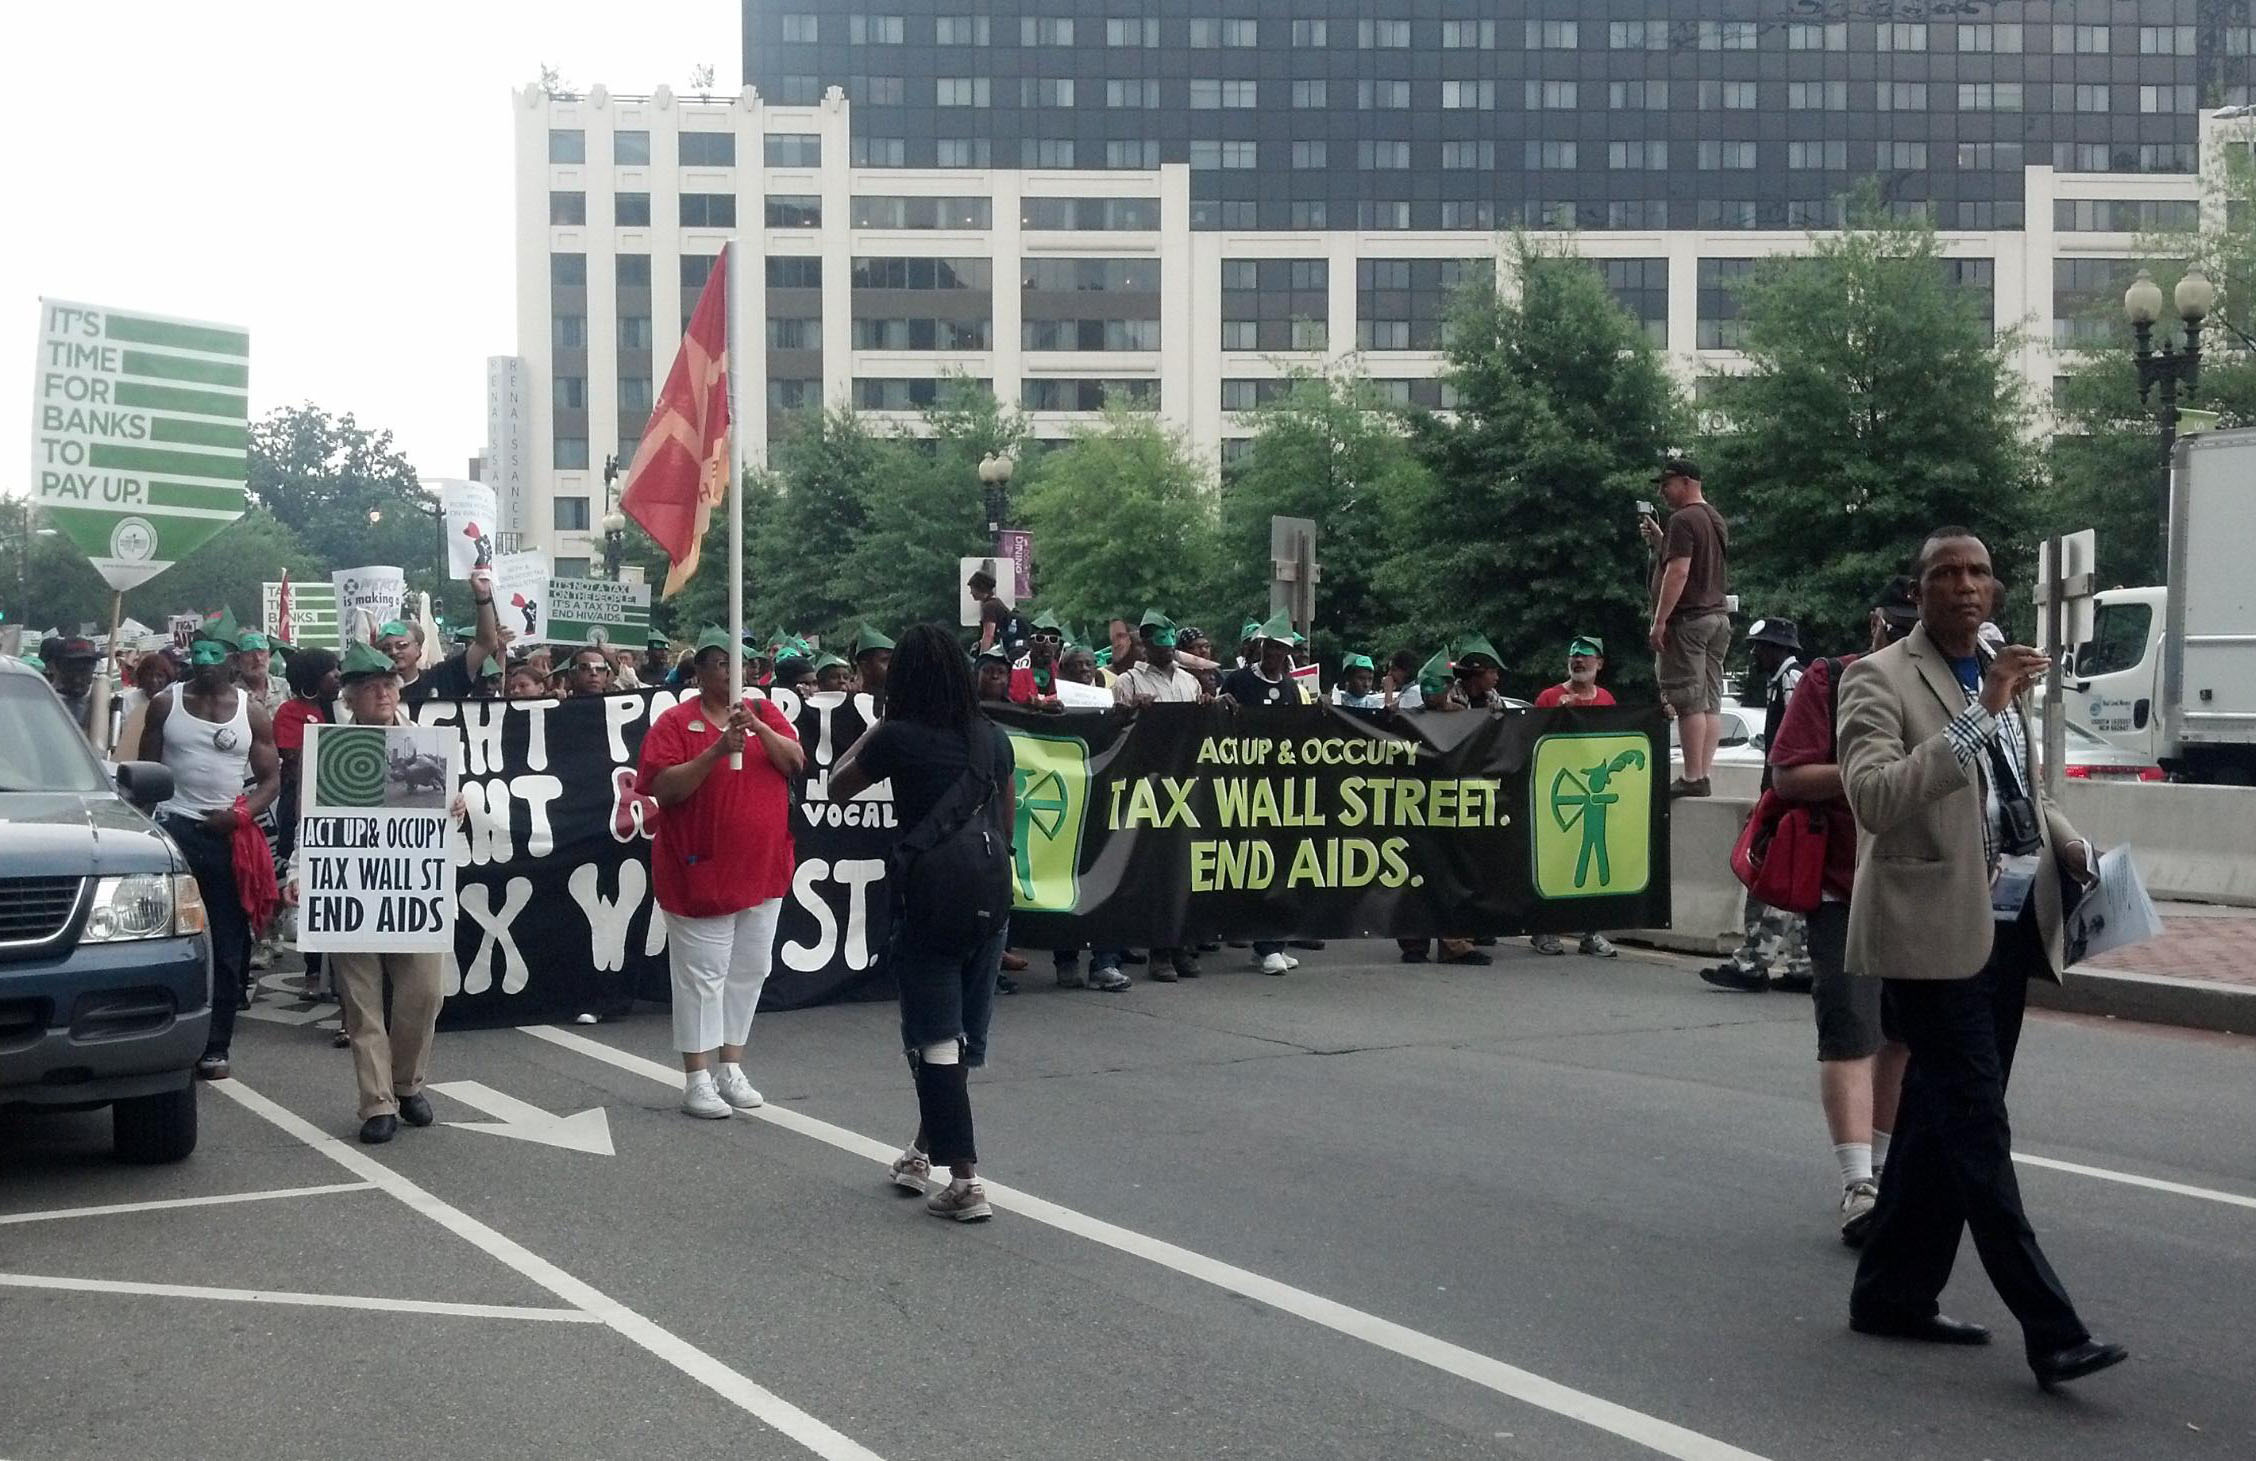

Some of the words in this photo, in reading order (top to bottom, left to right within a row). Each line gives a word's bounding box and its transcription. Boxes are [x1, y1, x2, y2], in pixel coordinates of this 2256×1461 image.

[49, 306, 99, 337] IT'S
[47, 339, 117, 373] TIME
[44, 373, 109, 404] FOR
[41, 405, 146, 440] BANKS
[491, 360, 500, 497] RENAISSAN
[41, 438, 84, 466] TO
[509, 360, 520, 529] RENAISSANCE
[41, 471, 97, 501] PAY
[103, 477, 143, 504] UP.
[1015, 535, 1024, 574] DINING
[343, 596, 352, 607] is
[356, 592, 394, 607] making
[552, 609, 573, 618] END
[553, 600, 570, 608] IT'S
[573, 601, 580, 609] A
[583, 602, 602, 610] TAX
[606, 603, 620, 612] TO
[268, 612, 315, 623] BNKS.
[268, 625, 296, 636] NT
[1277, 738, 1296, 765] &
[1302, 737, 1422, 766] OCCUPY
[801, 802, 898, 828] VOCAL
[1109, 776, 1201, 830] TAX
[1212, 776, 1325, 828] WALL
[1338, 776, 1511, 828] STREET.
[304, 818, 336, 847] ACT
[387, 818, 447, 848] OCCUPY
[309, 857, 349, 890] TAX
[358, 857, 412, 891] WALL
[421, 858, 446, 891] ST
[1190, 840, 1276, 892] END
[1287, 838, 1424, 888] AIDS.
[308, 896, 364, 932] END
[376, 896, 444, 933] AIDS
[781, 858, 886, 972] ST.
